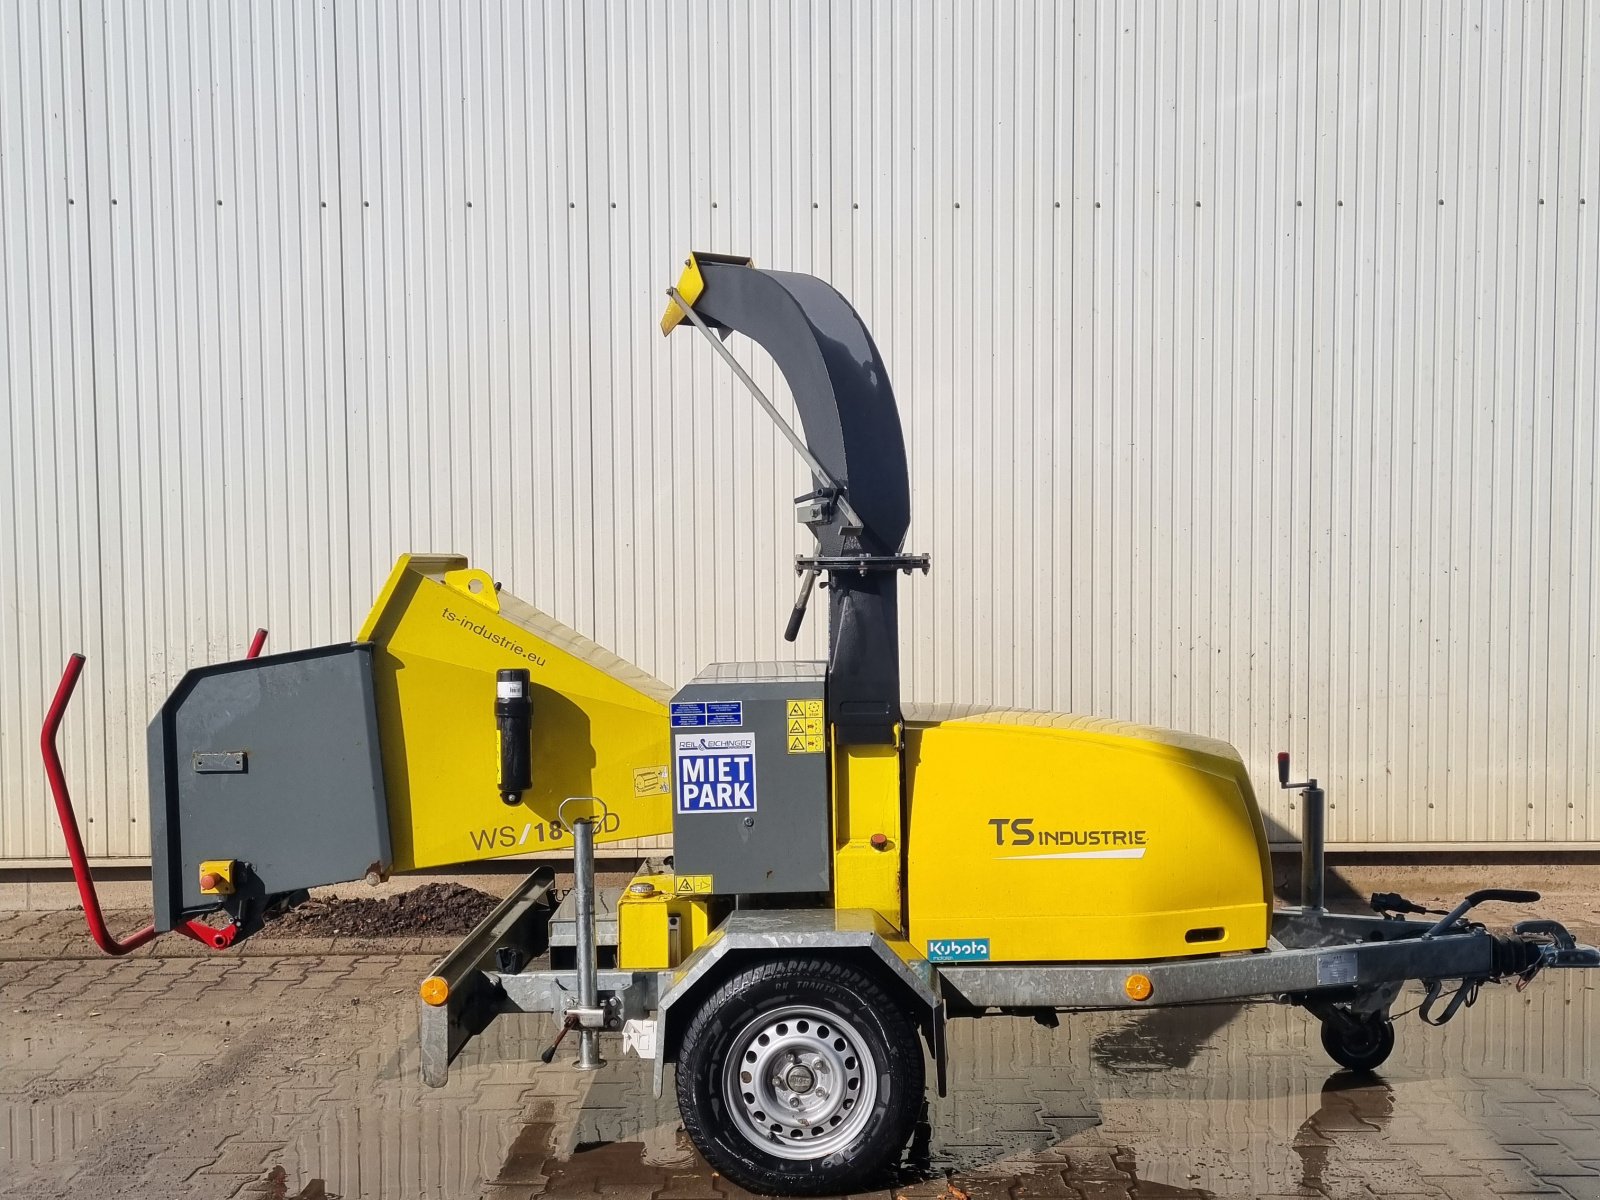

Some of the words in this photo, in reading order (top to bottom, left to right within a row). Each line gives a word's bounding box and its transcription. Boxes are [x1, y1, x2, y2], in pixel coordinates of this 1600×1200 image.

[442, 607, 546, 667] ts-industrie.eu
[708, 740, 752, 748] EICHINGER
[682, 757, 750, 782] MIET
[683, 783, 751, 808] PARK
[470, 812, 620, 851] WS/18-5D
[988, 818, 1035, 846] TS
[1038, 831, 1147, 845] INDUSTRIE
[930, 941, 987, 955] Kubota
